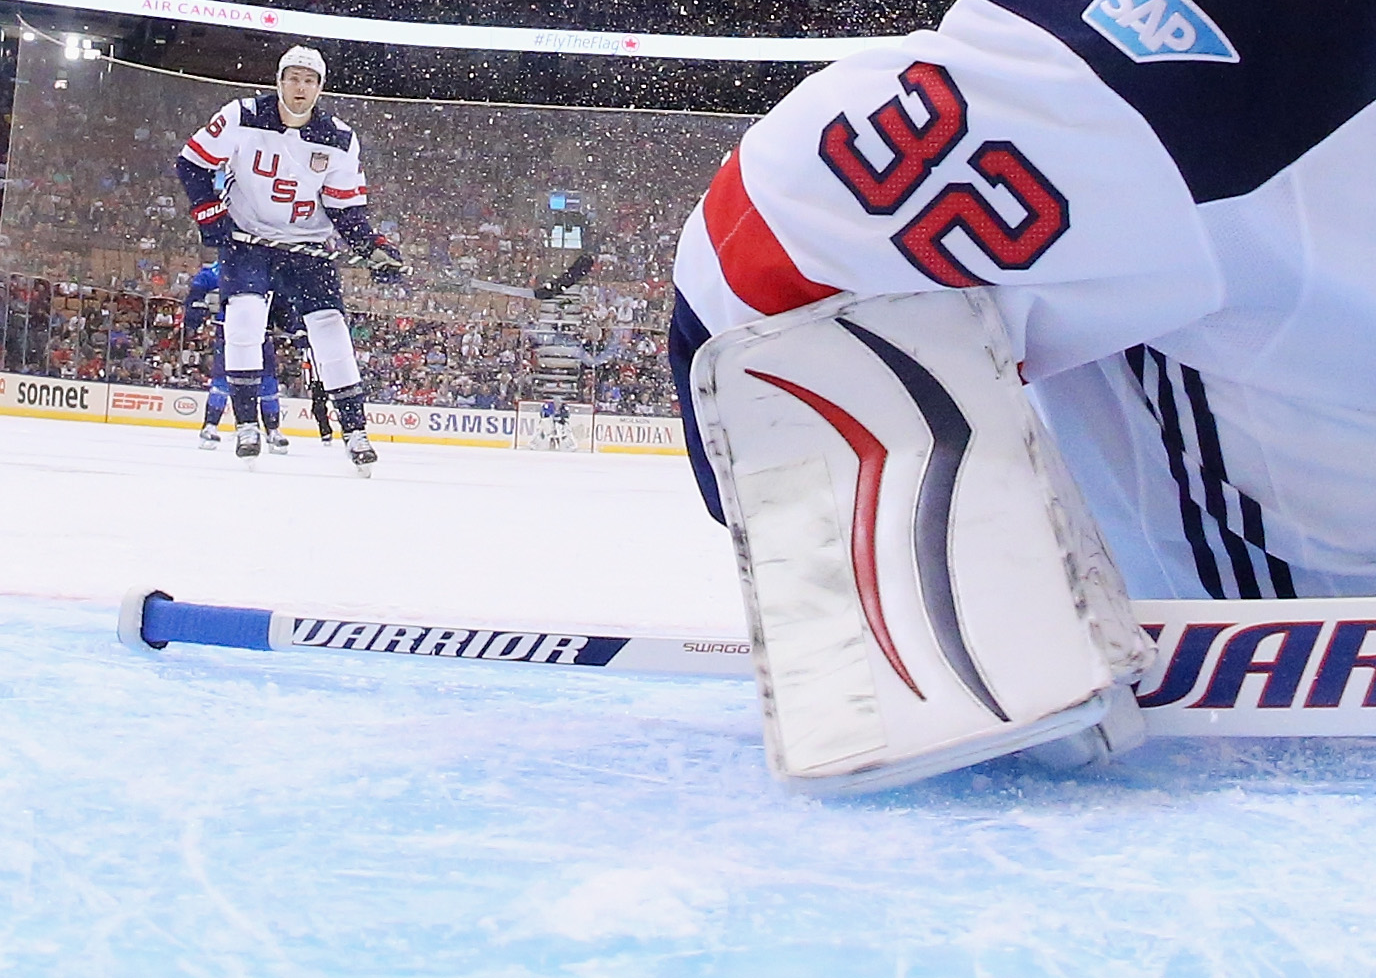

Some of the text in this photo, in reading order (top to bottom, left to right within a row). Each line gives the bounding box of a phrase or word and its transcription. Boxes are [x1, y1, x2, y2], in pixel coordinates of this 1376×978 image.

[142, 0, 252, 21] AIR CANADA
[535, 32, 621, 55] #FlyTheFlag
[818, 61, 1070, 288] 32
[17, 381, 89, 410] sonnet
[112, 392, 164, 412] ESPN
[428, 412, 535, 436] SAMSUN
[595, 424, 673, 444] CANADIAN
[292, 619, 589, 664] WARRIOR
[683, 642, 751, 654] SWAGG
